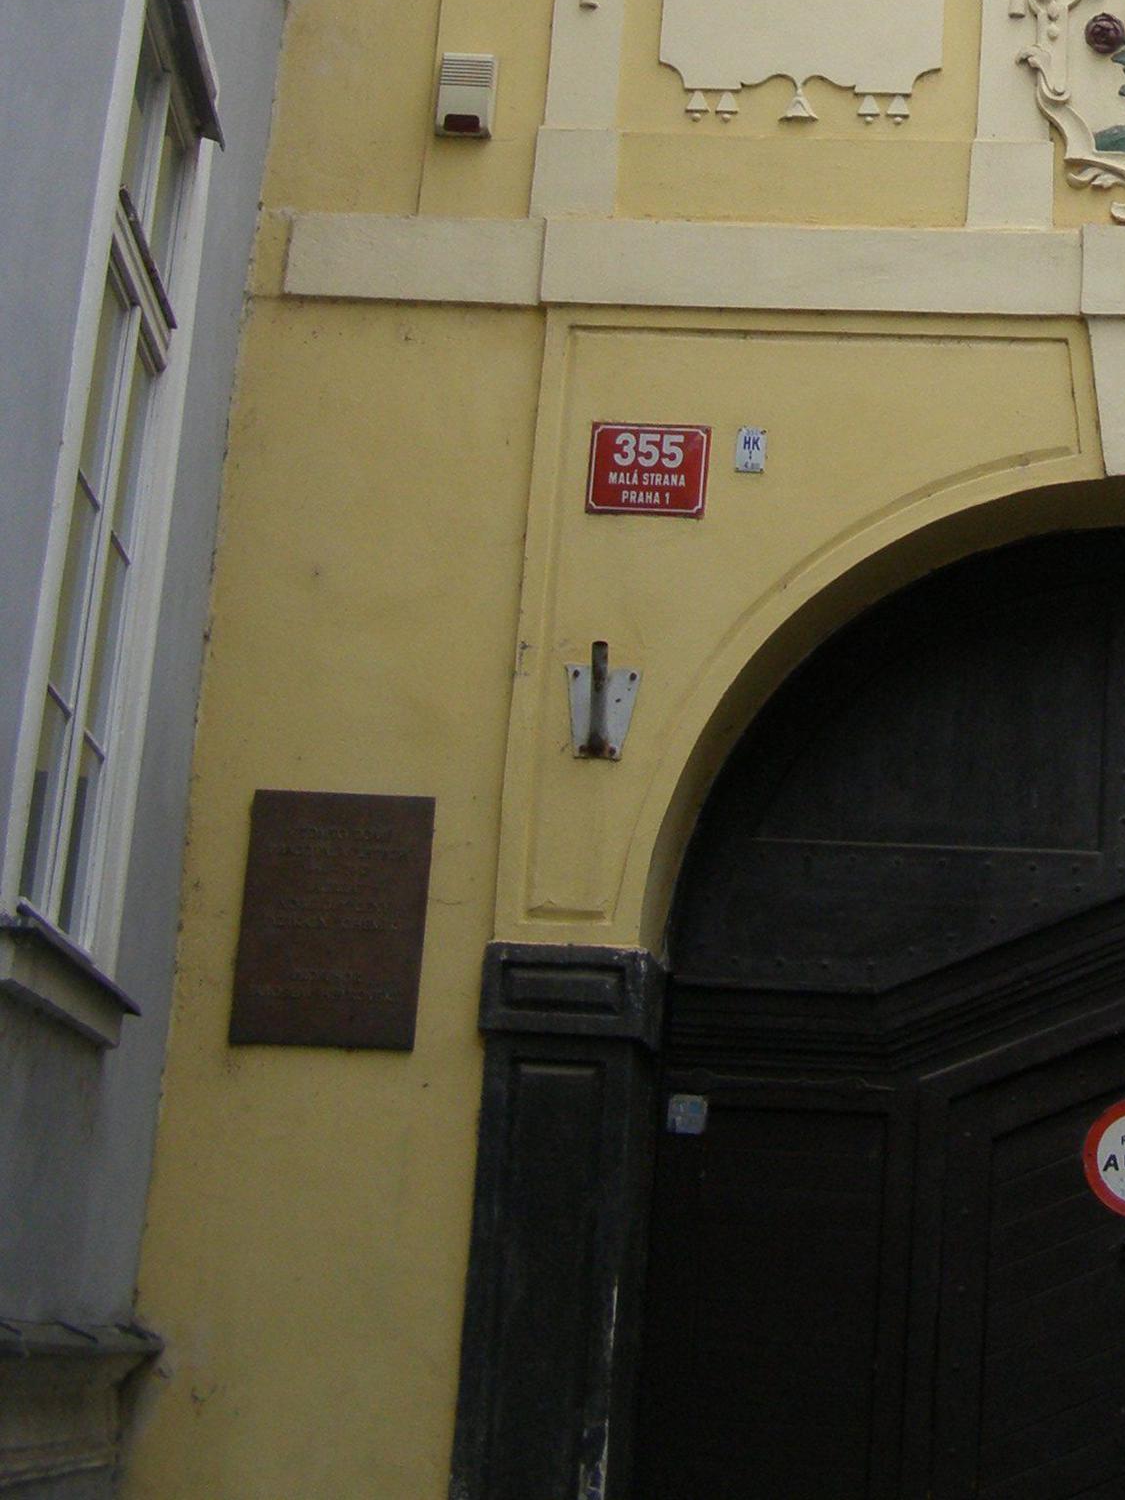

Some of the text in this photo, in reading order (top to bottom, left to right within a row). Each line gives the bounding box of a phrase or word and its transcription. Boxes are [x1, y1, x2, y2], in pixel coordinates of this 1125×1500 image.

[614, 432, 685, 469] 355
[743, 435, 761, 451] HK
[608, 469, 686, 488] MALÁ STRANA
[621, 490, 671, 505] PRAHA 1
